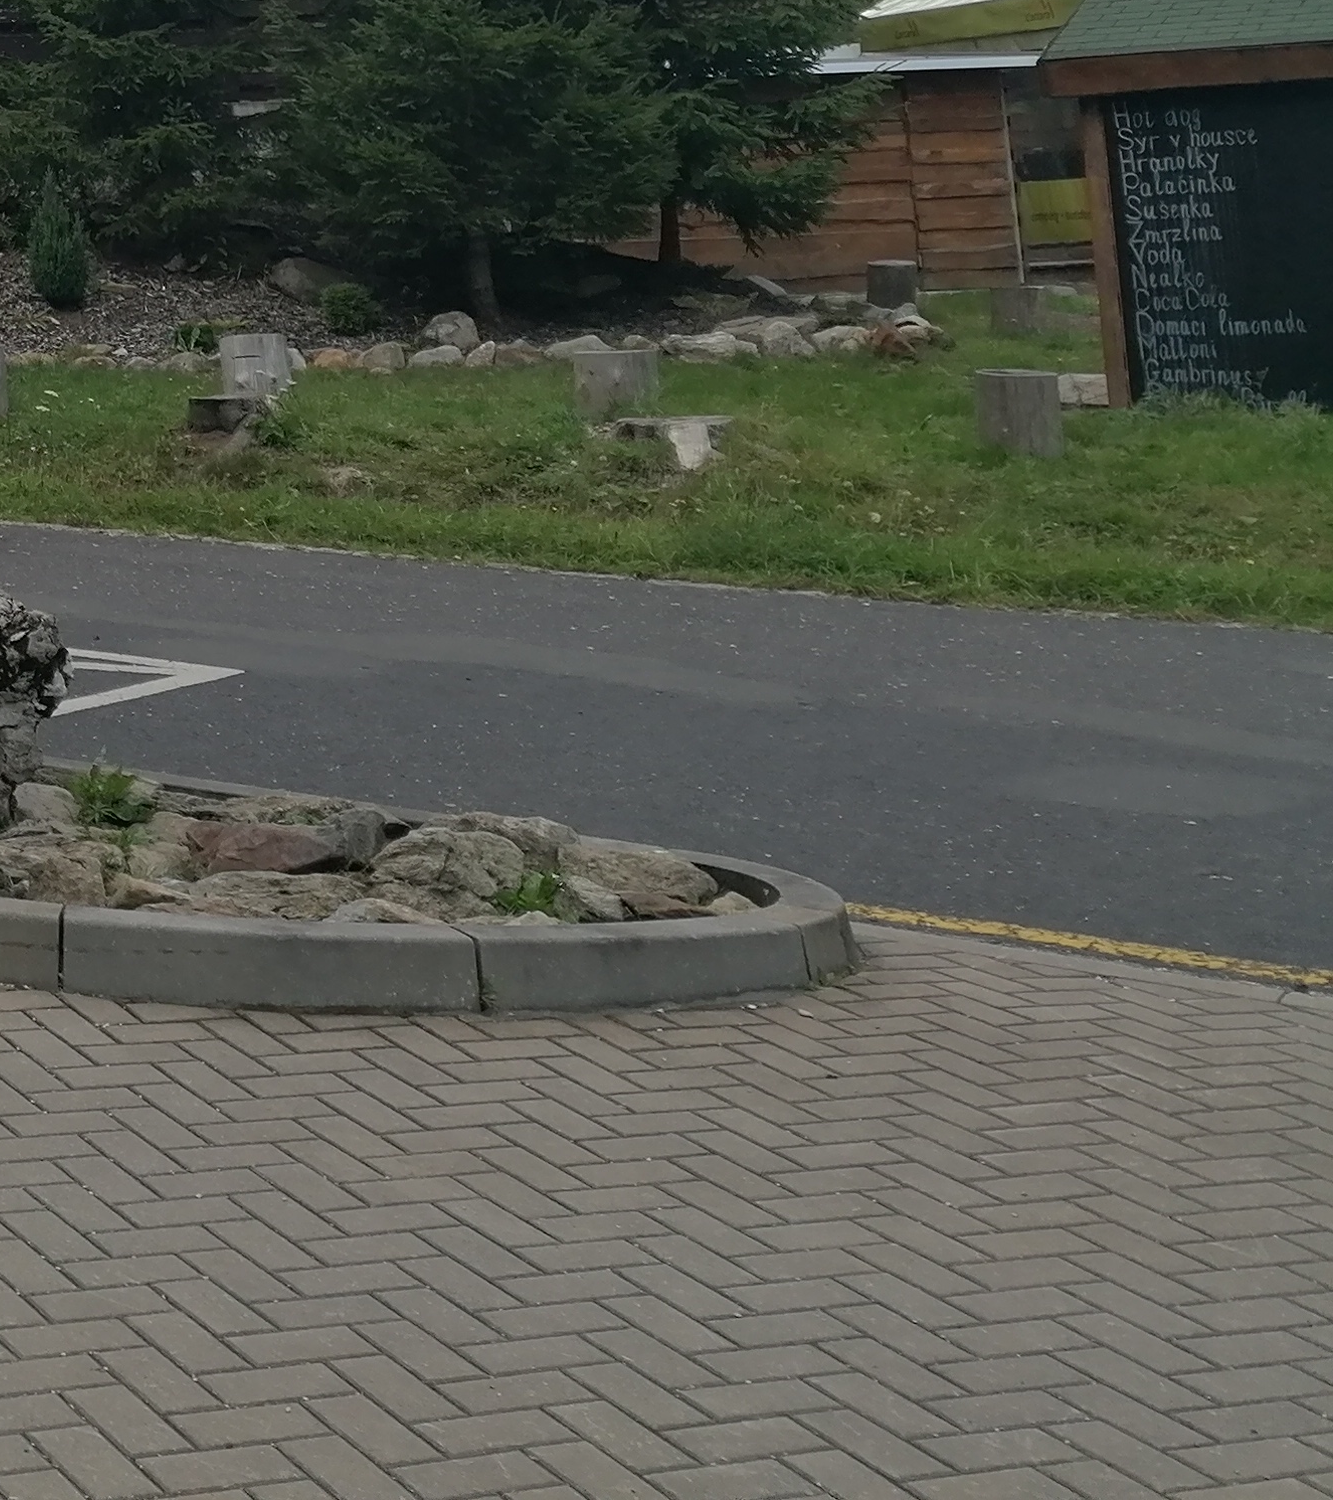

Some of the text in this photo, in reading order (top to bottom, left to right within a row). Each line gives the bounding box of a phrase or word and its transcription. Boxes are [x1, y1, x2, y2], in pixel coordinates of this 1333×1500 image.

[1189, 124, 1258, 148] housce
[1119, 146, 1220, 174] Hranolky
[1126, 218, 1223, 245] Zmrzlina
[1129, 240, 1185, 266] Voda
[1131, 263, 1205, 289] Nealko
[1135, 288, 1182, 313] Coca
[1144, 358, 1253, 387] Gambrinus
